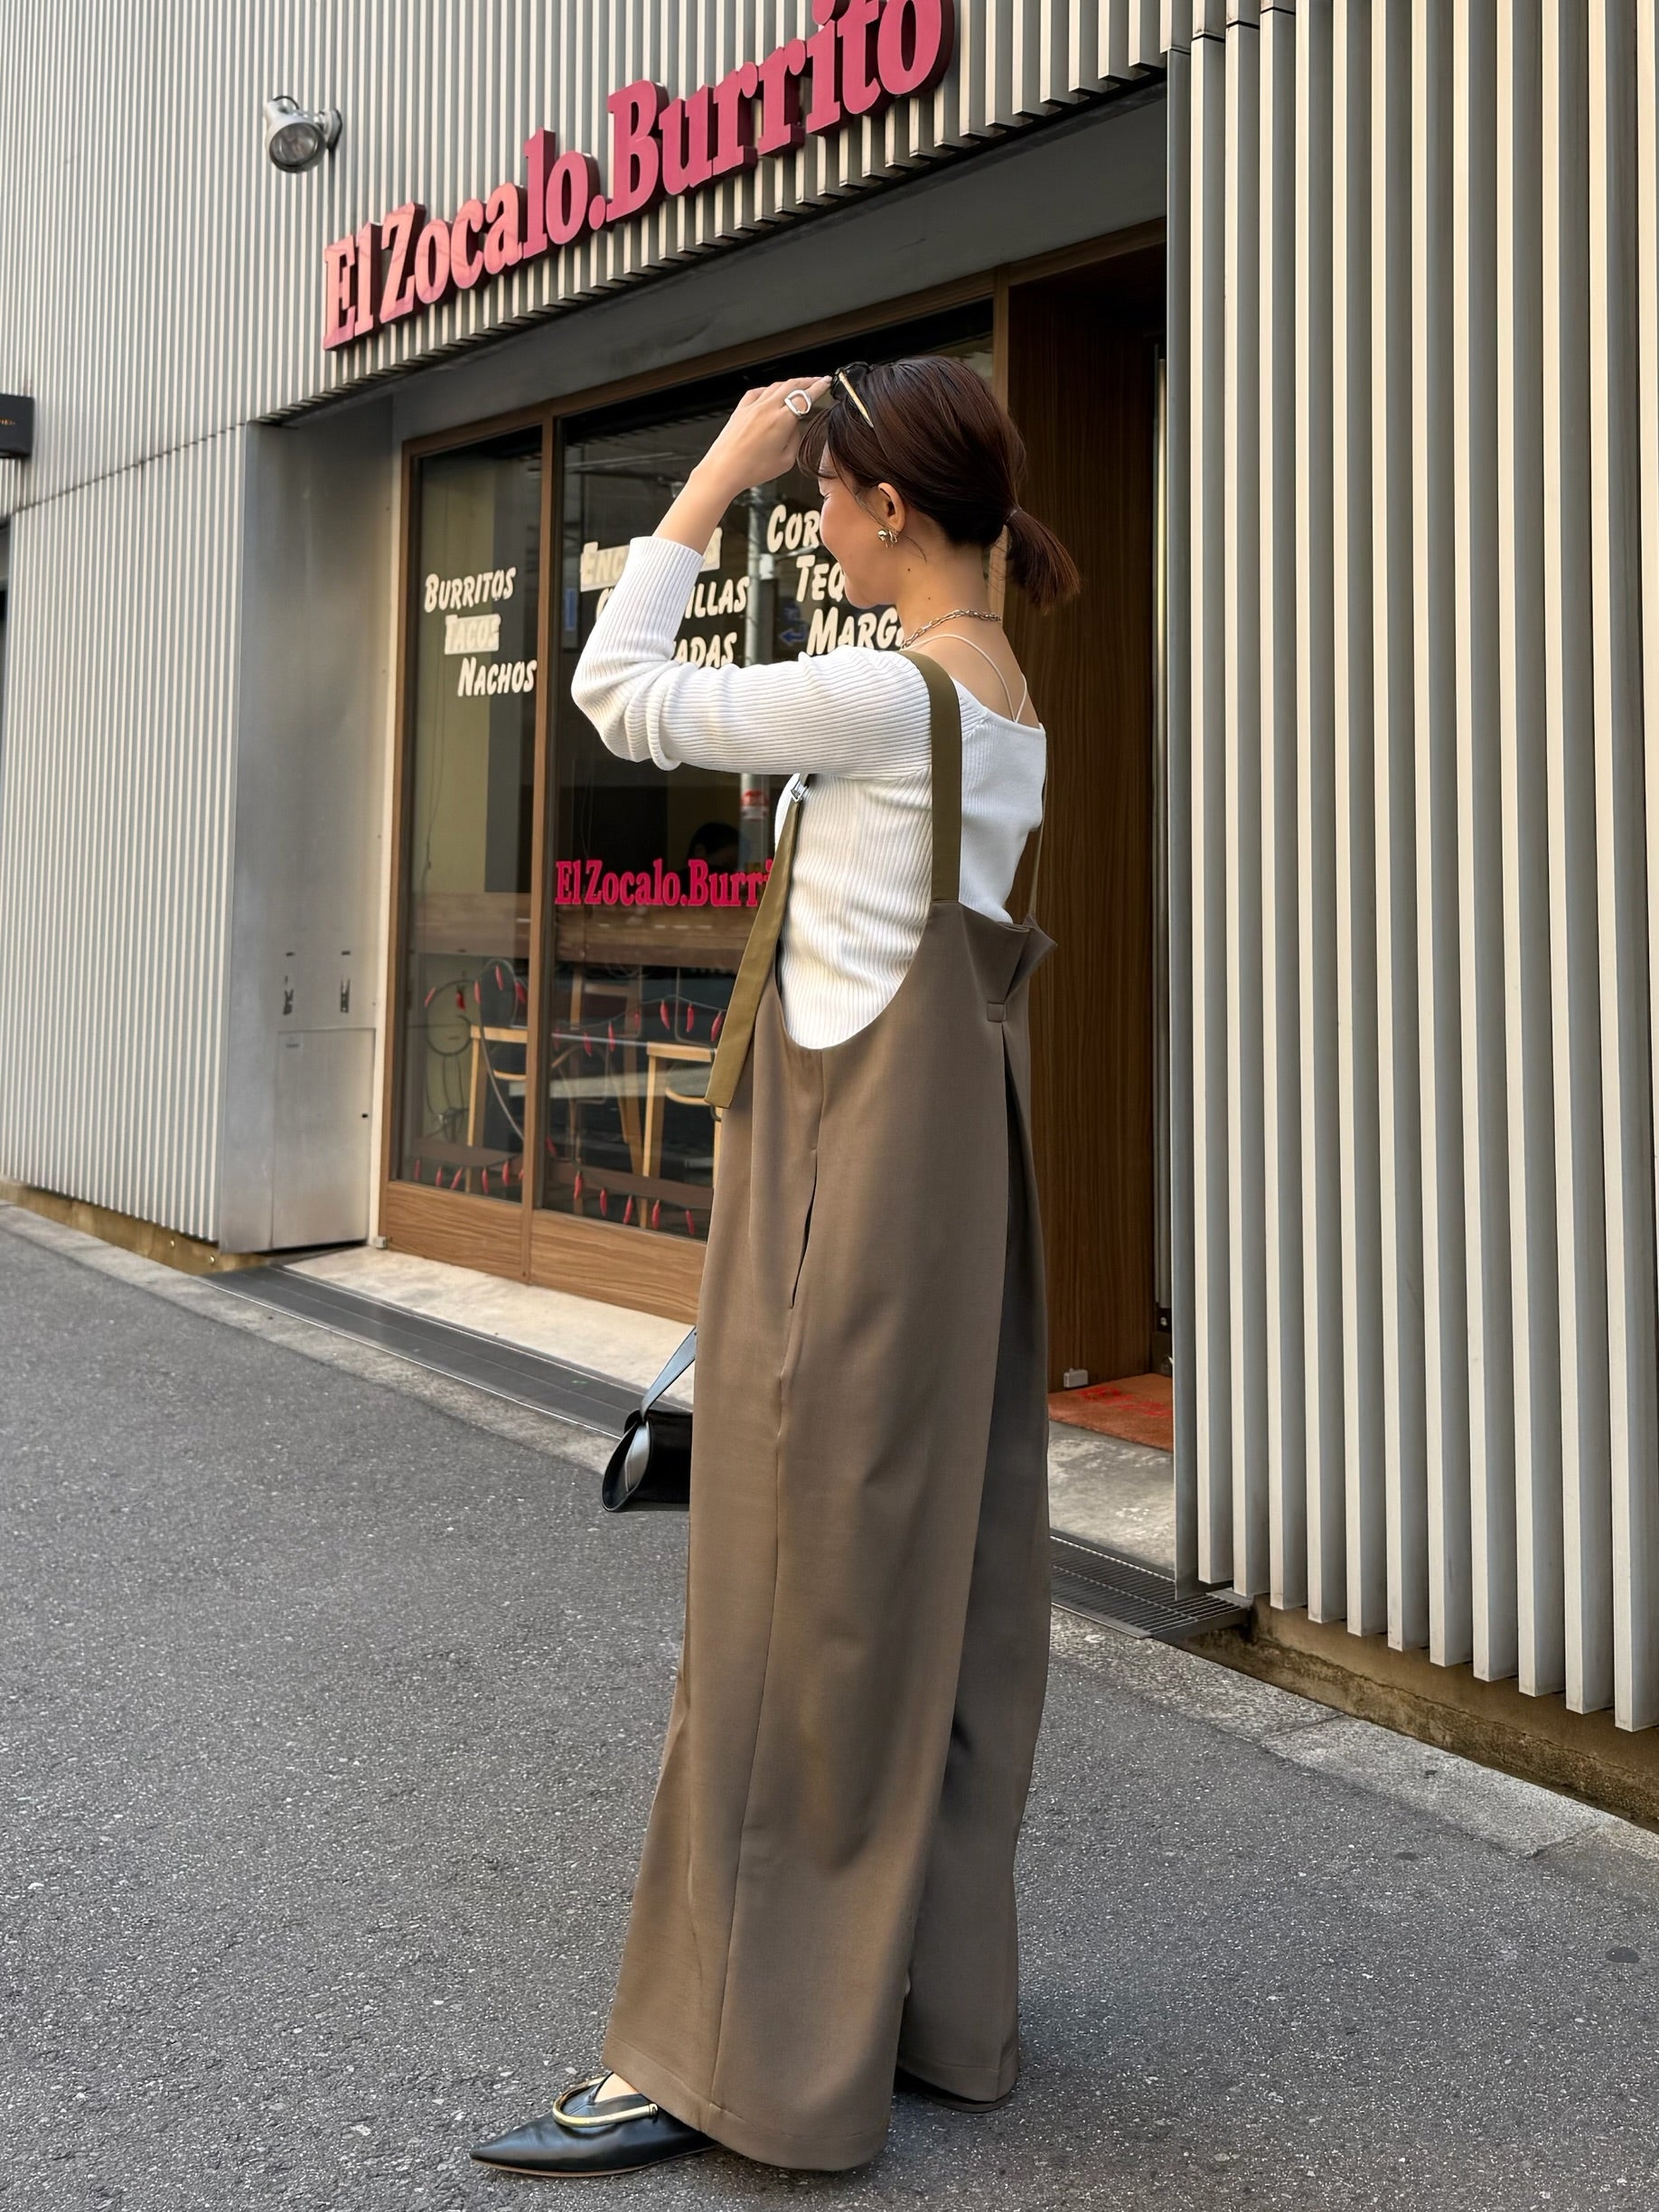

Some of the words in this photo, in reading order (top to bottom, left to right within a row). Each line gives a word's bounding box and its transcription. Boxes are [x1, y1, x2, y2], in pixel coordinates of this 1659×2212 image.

[767, 504, 820, 554] COR
[424, 567, 517, 614] BURRITOS
[796, 554, 846, 603] TEQ
[445, 614, 501, 655] TACOS
[674, 632, 737, 669] ADAS
[806, 606, 904, 656] MARG
[457, 656, 538, 698] NACHOS
